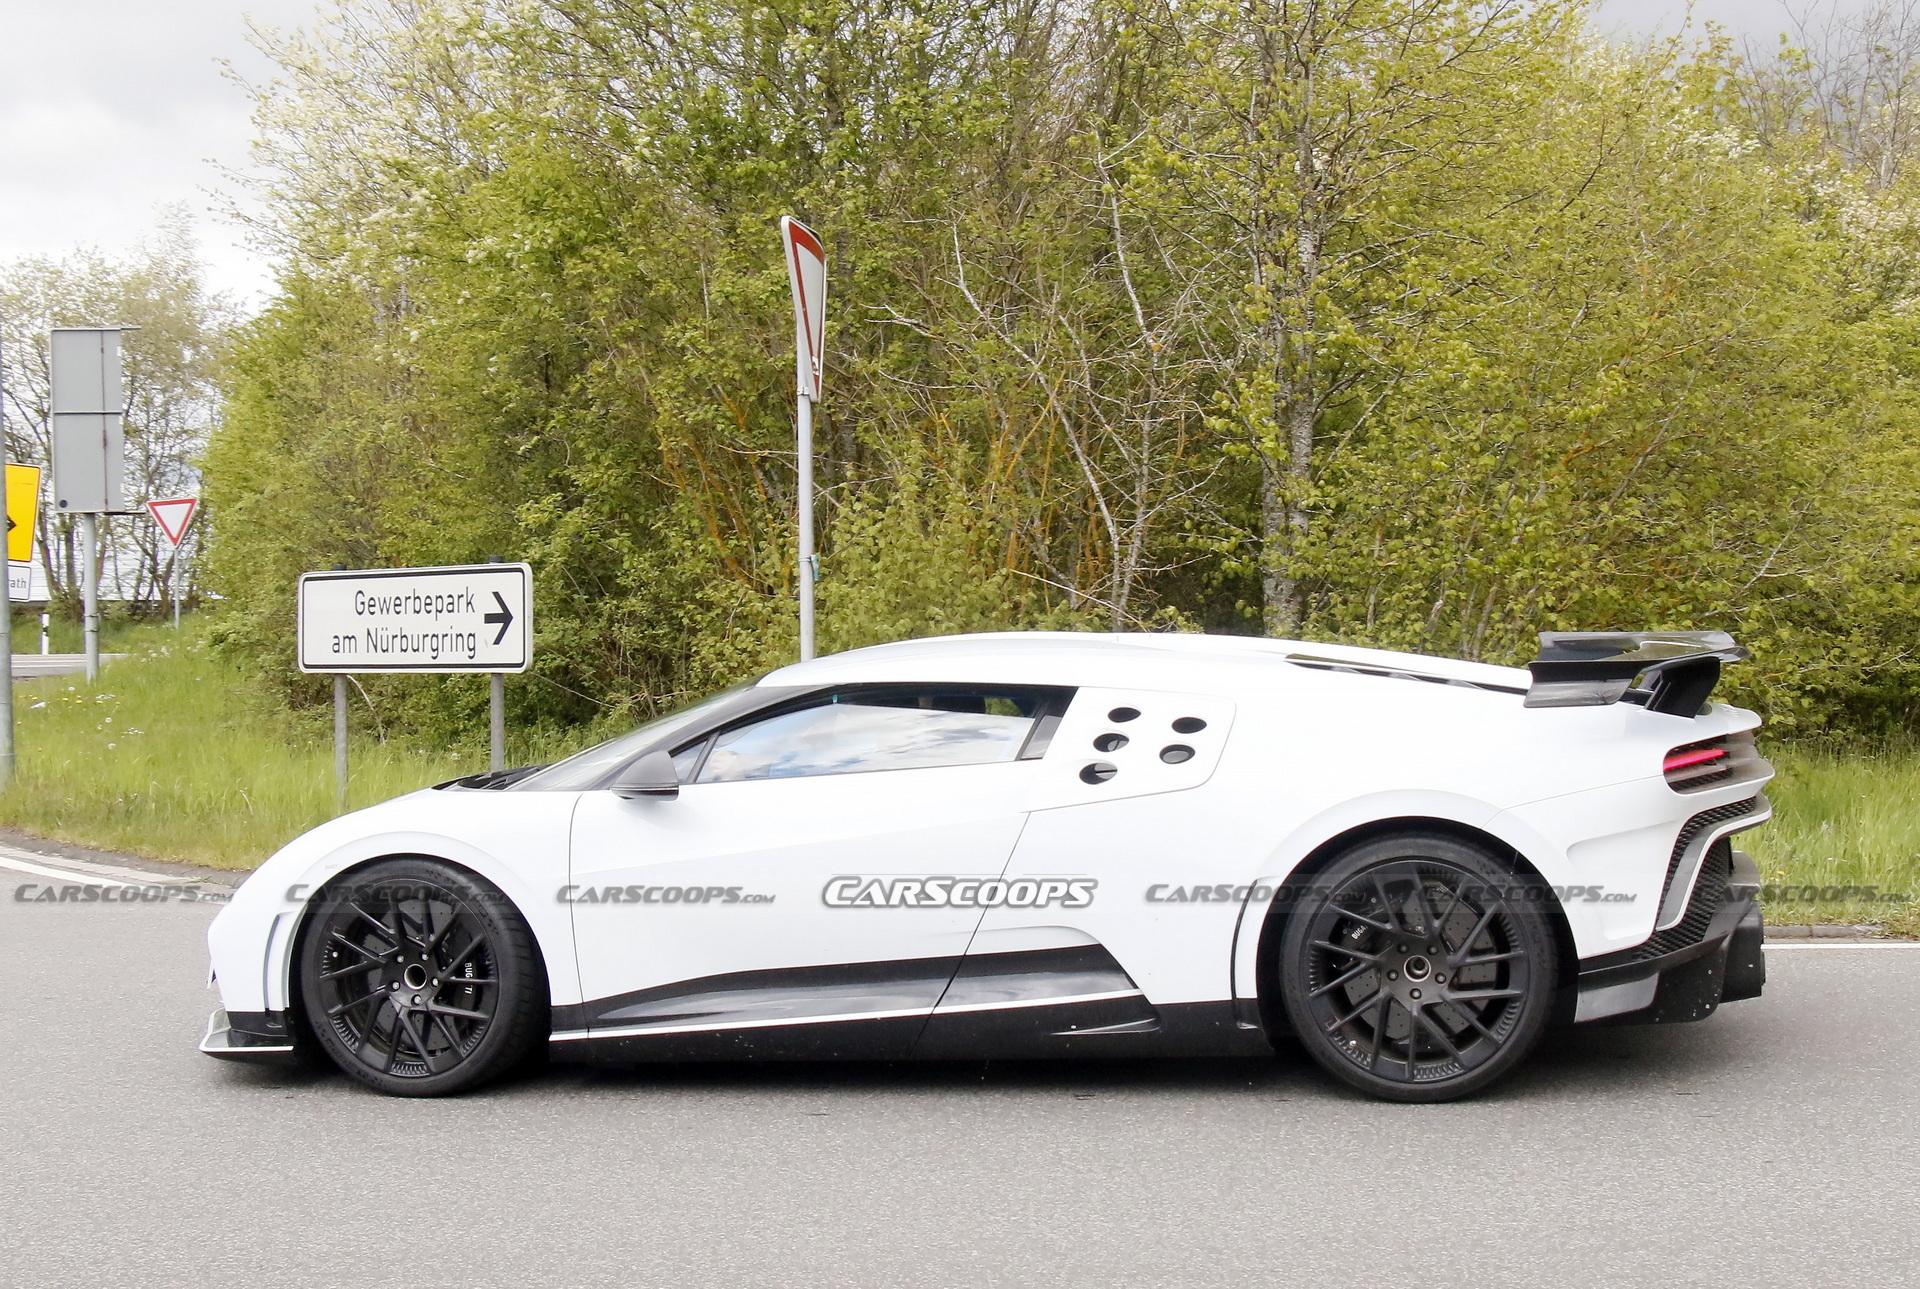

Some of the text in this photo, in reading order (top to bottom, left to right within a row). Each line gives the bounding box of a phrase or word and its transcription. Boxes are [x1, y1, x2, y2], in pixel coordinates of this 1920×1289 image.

[355, 586, 475, 621] Gewerbepark
[332, 626, 476, 660] am Nürburgring
[1351, 925, 1368, 940] BUGA
[465, 962, 473, 994] BUGTI
